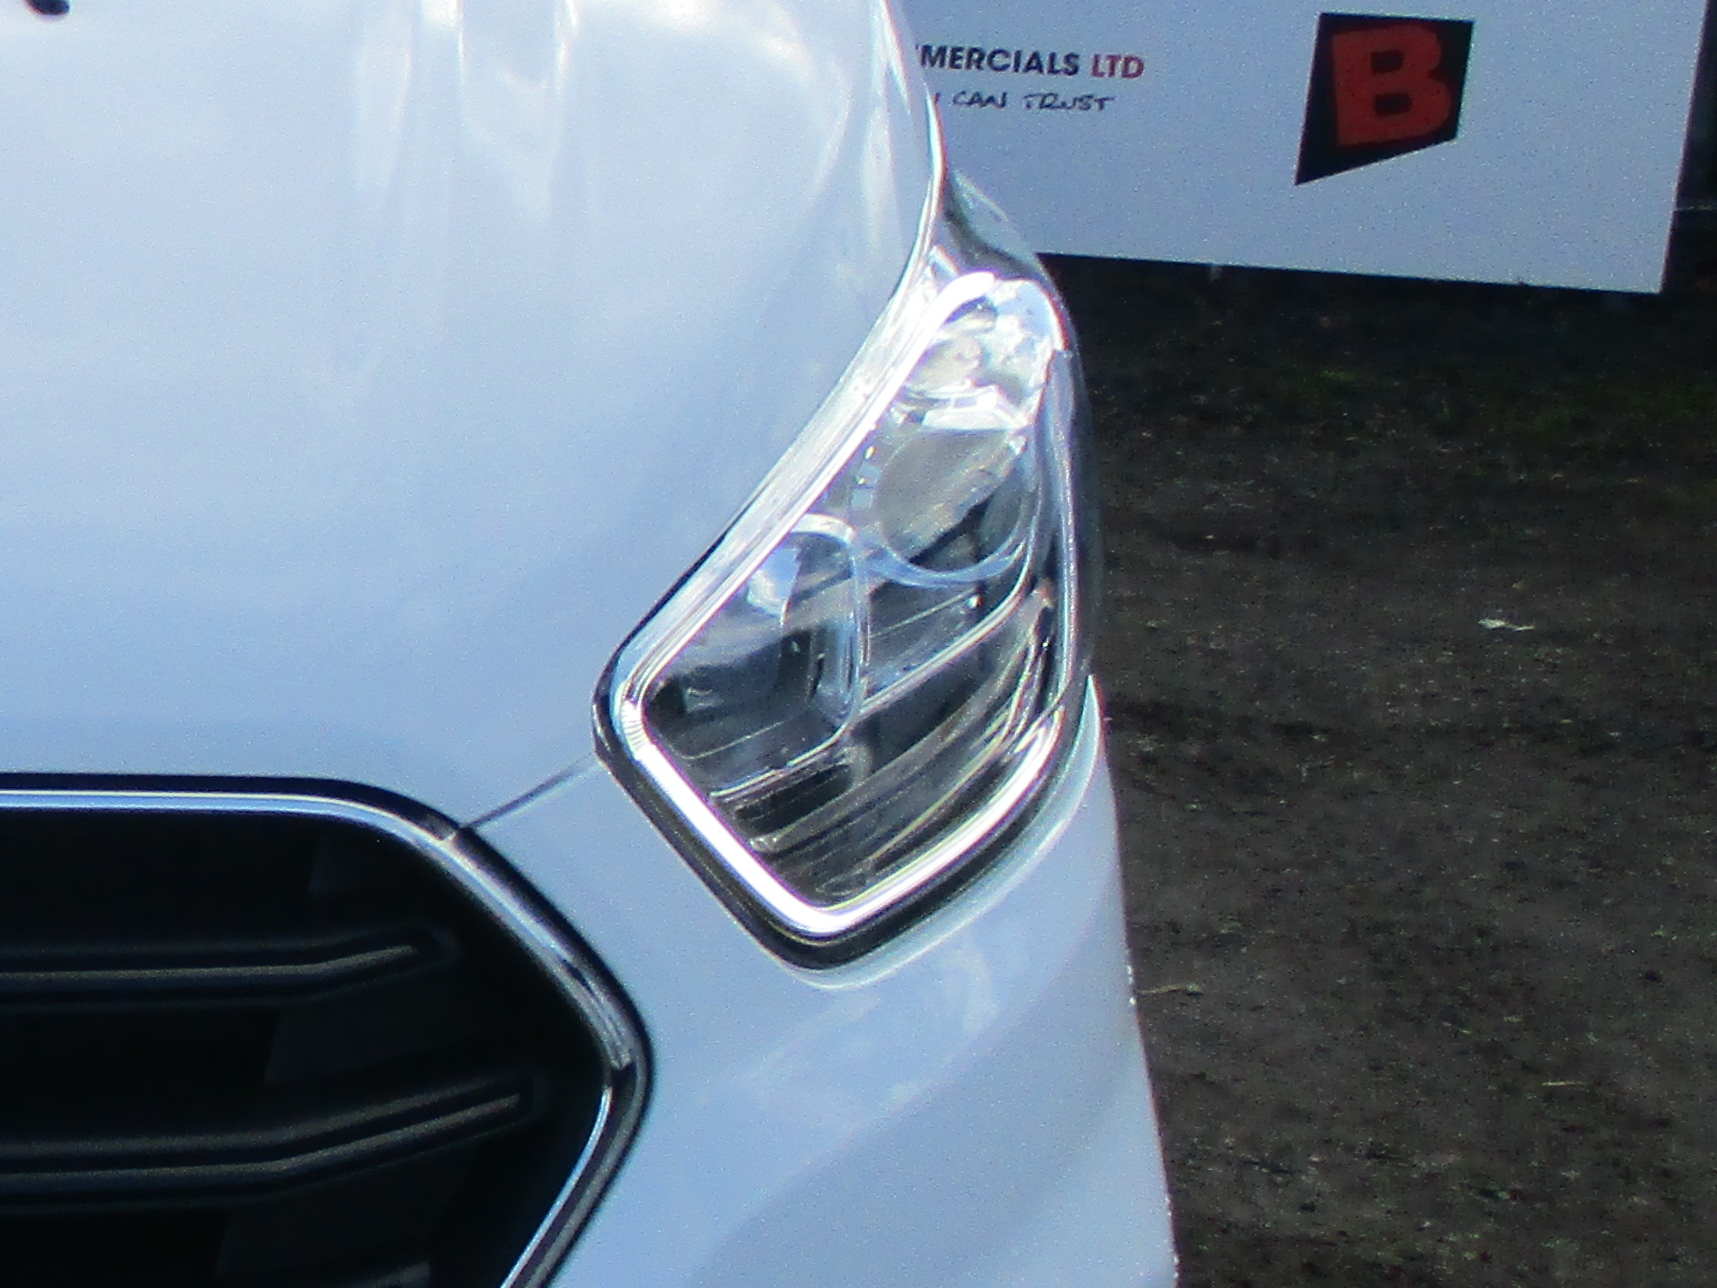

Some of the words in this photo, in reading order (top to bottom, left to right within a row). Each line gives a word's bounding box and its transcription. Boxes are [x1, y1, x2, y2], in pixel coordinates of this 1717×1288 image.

[916, 44, 1081, 76] MERCIALS
[1091, 54, 1145, 79] LTD
[952, 91, 1008, 108] CAN
[1023, 91, 1115, 111] TRUST
[1331, 22, 1452, 148] B
